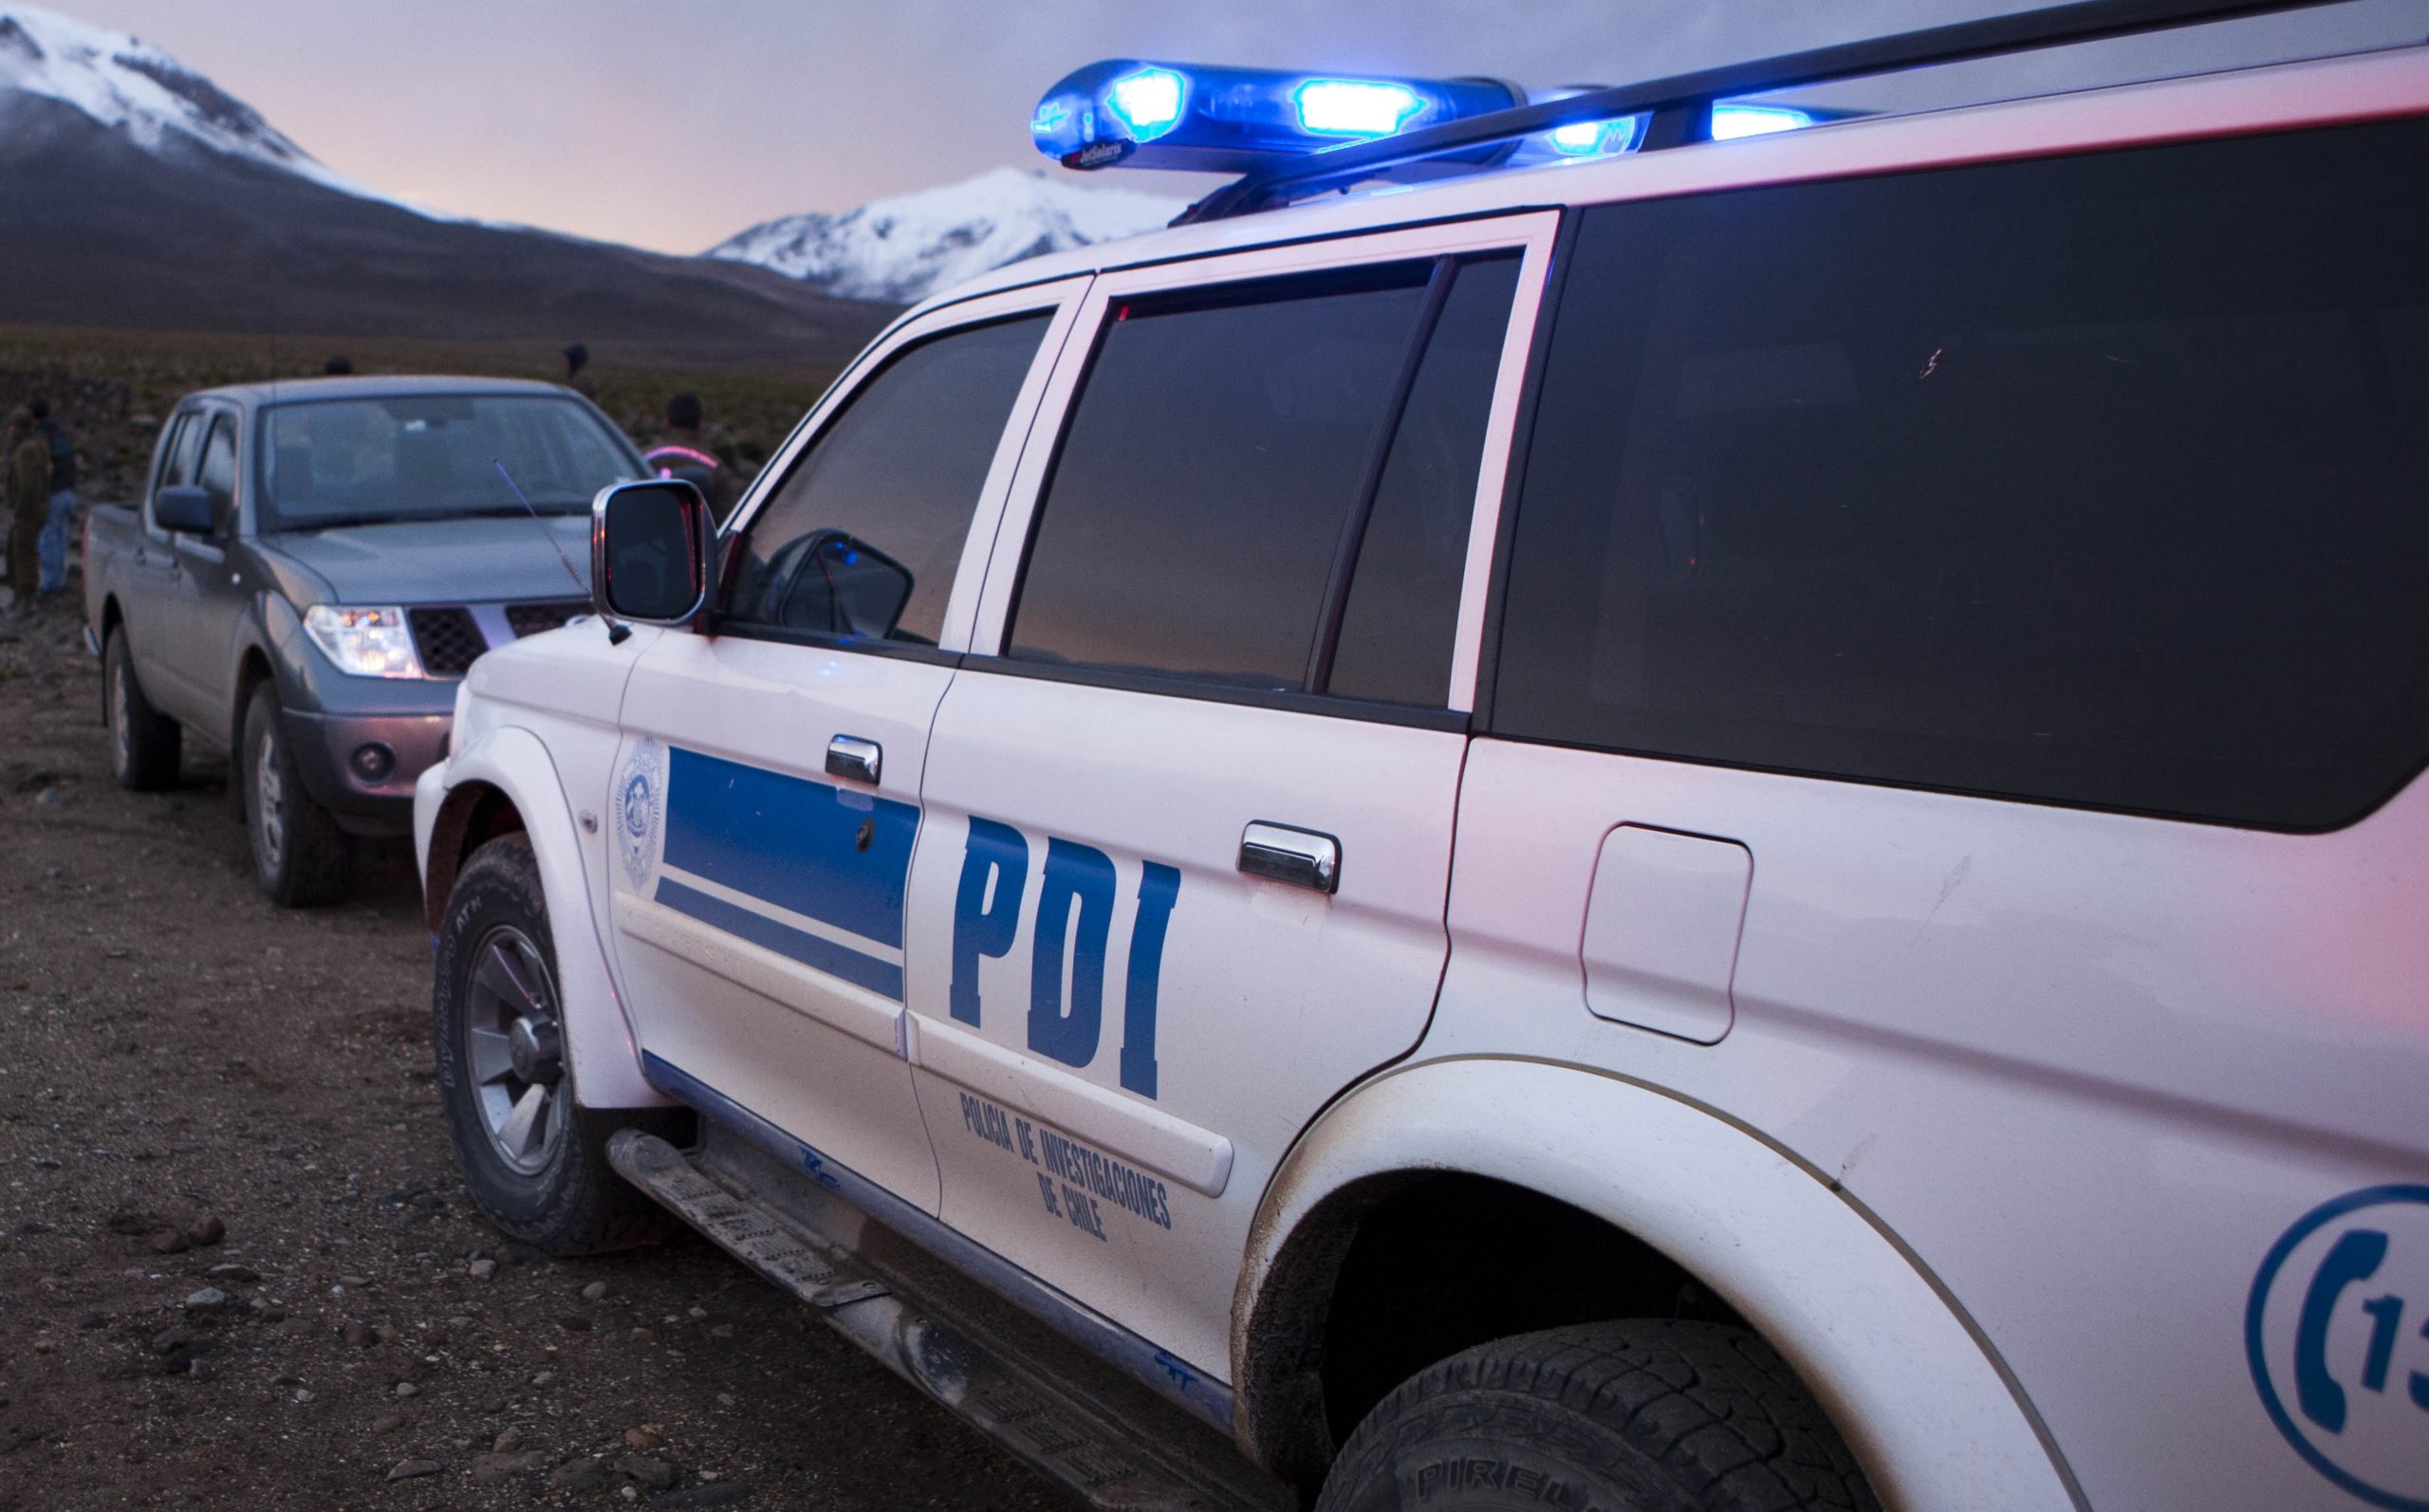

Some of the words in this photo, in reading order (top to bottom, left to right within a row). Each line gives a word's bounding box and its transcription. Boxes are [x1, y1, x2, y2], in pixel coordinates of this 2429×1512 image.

[950, 815, 1180, 1100] PDI
[959, 1091, 1014, 1153] POLICIA
[1015, 1116, 1039, 1165] DE
[1039, 1129, 1171, 1230] INVESTIGACIONES
[1037, 1171, 1063, 1218] DE
[1062, 1183, 1107, 1243] CHILE
